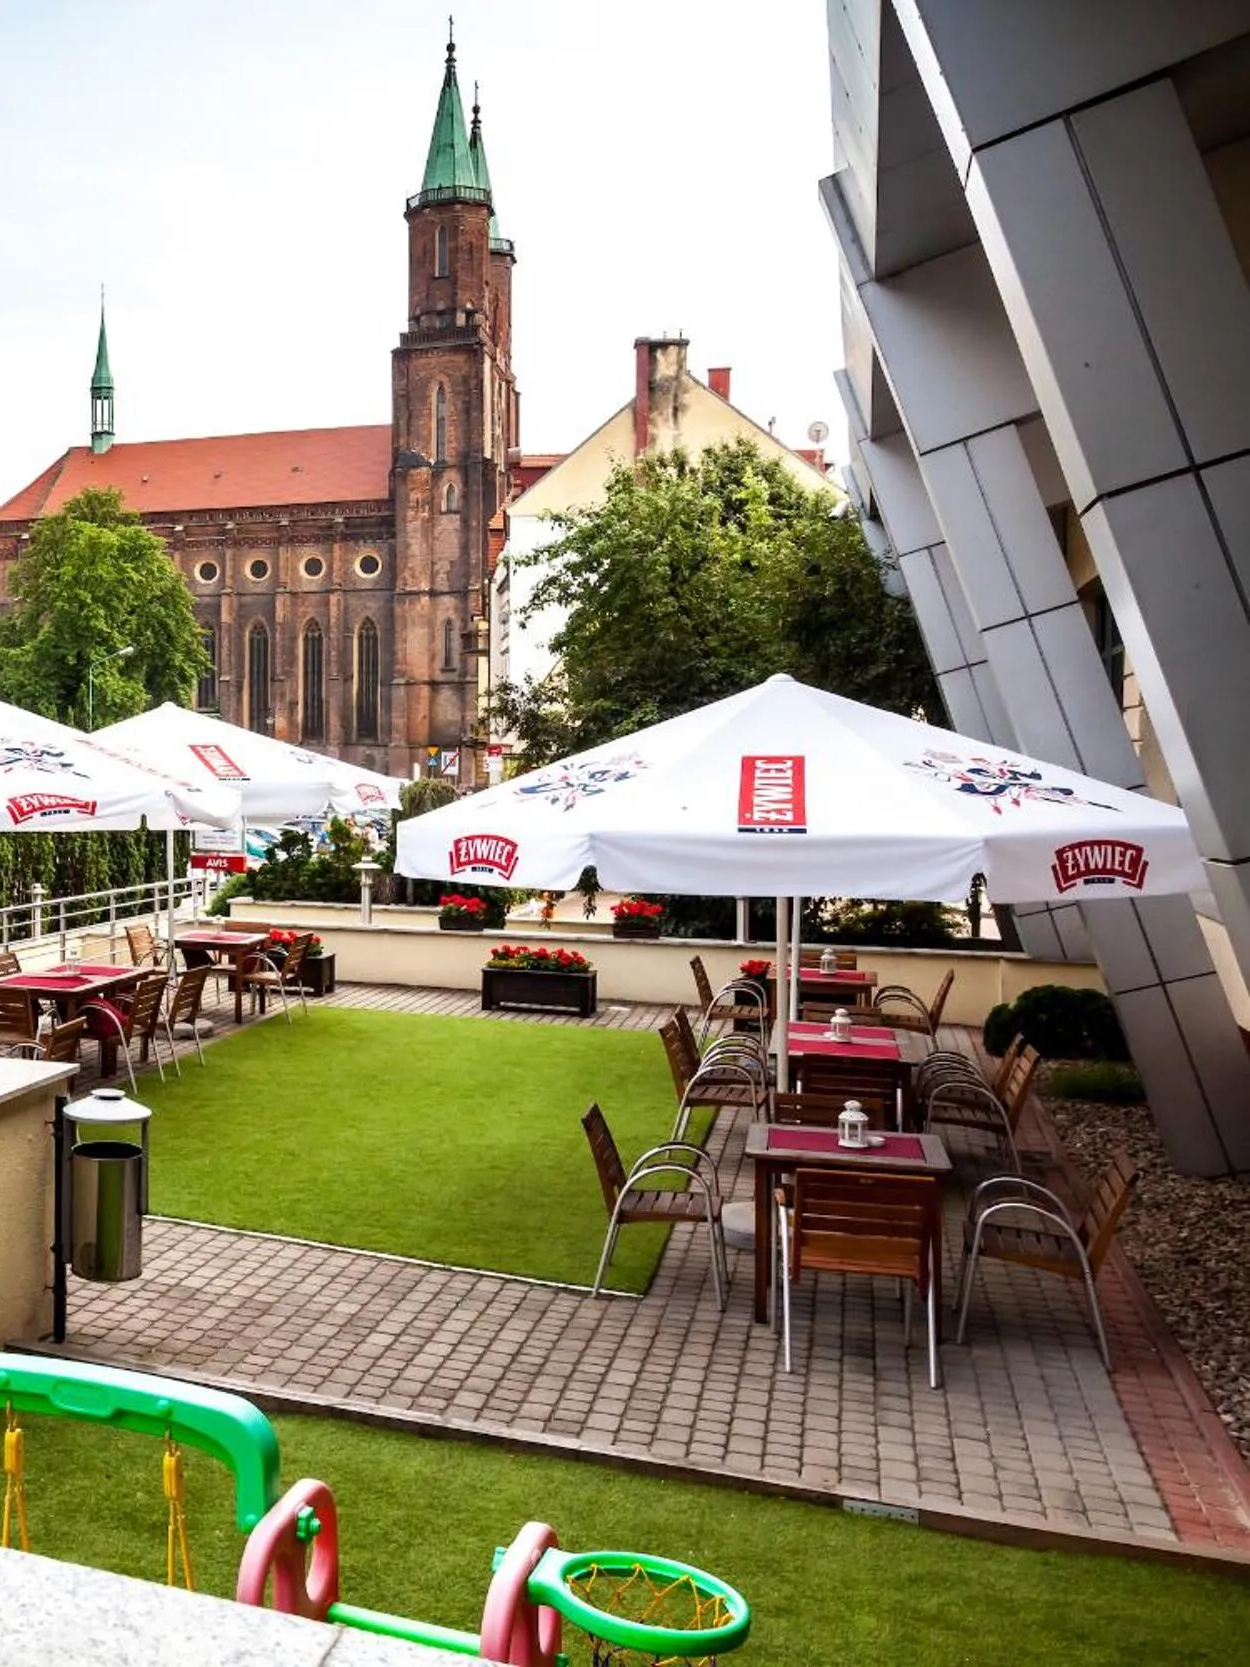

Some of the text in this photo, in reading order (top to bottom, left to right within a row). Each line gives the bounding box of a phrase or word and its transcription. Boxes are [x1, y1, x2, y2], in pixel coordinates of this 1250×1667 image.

[744, 759, 794, 822] ŻYWIEC
[206, 858, 229, 869] AVIS
[458, 837, 513, 867] ŻYWIEC
[1062, 844, 1137, 875] ŻYWIEC
